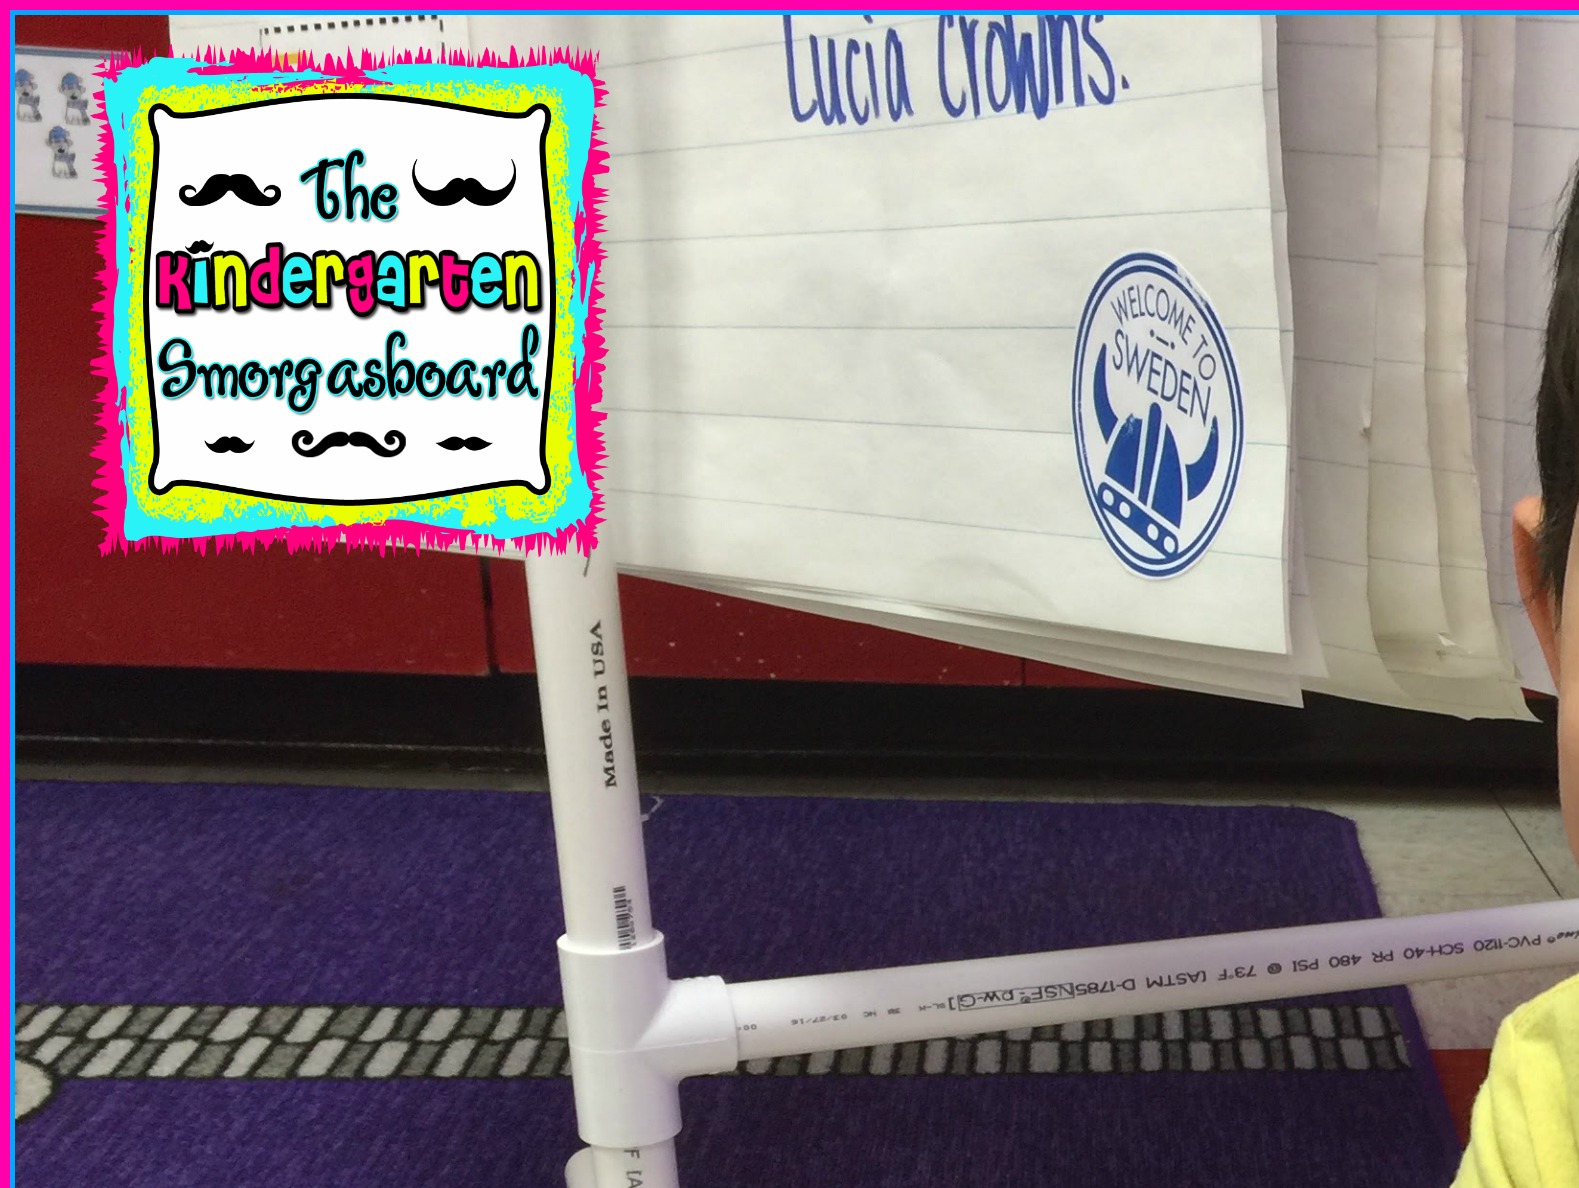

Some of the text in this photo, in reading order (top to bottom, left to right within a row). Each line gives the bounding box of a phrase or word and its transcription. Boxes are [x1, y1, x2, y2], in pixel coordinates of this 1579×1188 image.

[1110, 284, 1217, 381] WELCOME TO
[1112, 328, 1212, 428] SWEDEN
[589, 619, 618, 788] Made In USA
[1403, 942, 1465, 960] SCH-40
[1473, 934, 1542, 953] PVC-1120
[1292, 958, 1320, 973] PSI
[1328, 954, 1362, 968] 480
[1372, 951, 1394, 963] PR
